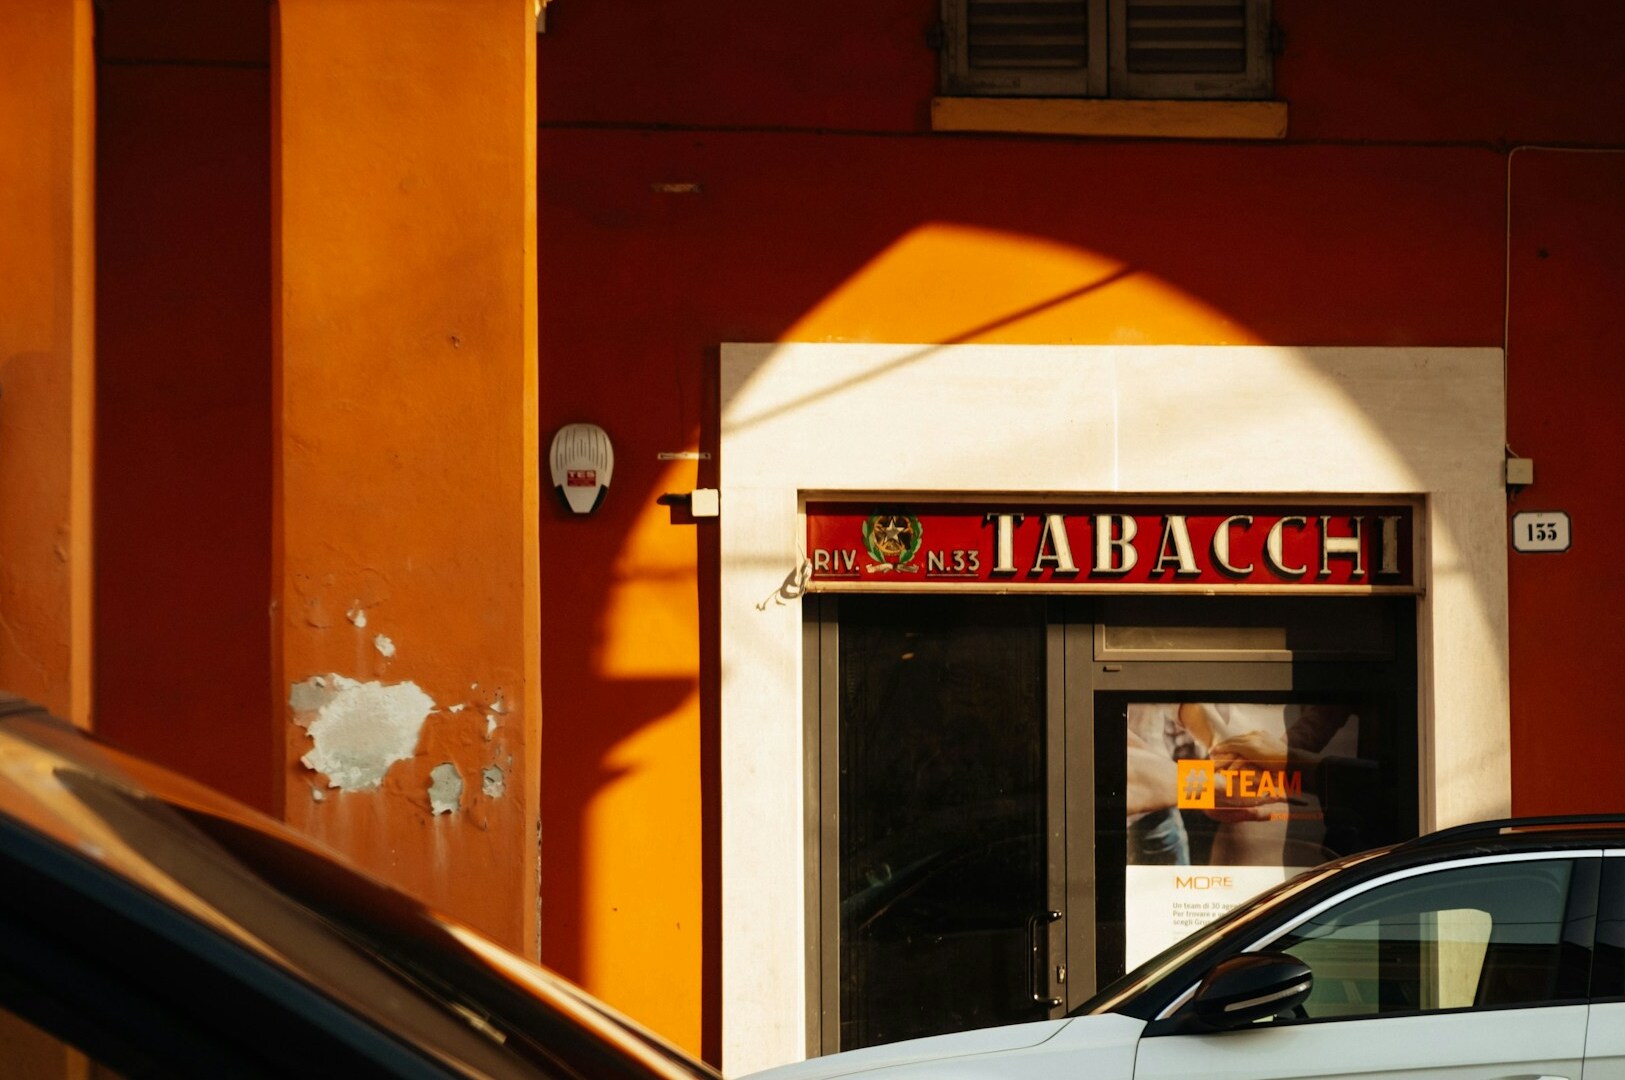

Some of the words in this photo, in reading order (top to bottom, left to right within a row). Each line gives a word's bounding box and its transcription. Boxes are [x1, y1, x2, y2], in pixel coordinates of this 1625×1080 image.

[813, 549, 860, 571] RIV.
[928, 550, 980, 572] N.33
[984, 513, 1402, 574] TABACCHI
[1220, 770, 1302, 798] TEAM
[1175, 875, 1233, 890] MORE
[1212, 902, 1221, 910] 30
[1173, 918, 1193, 926] scegli
